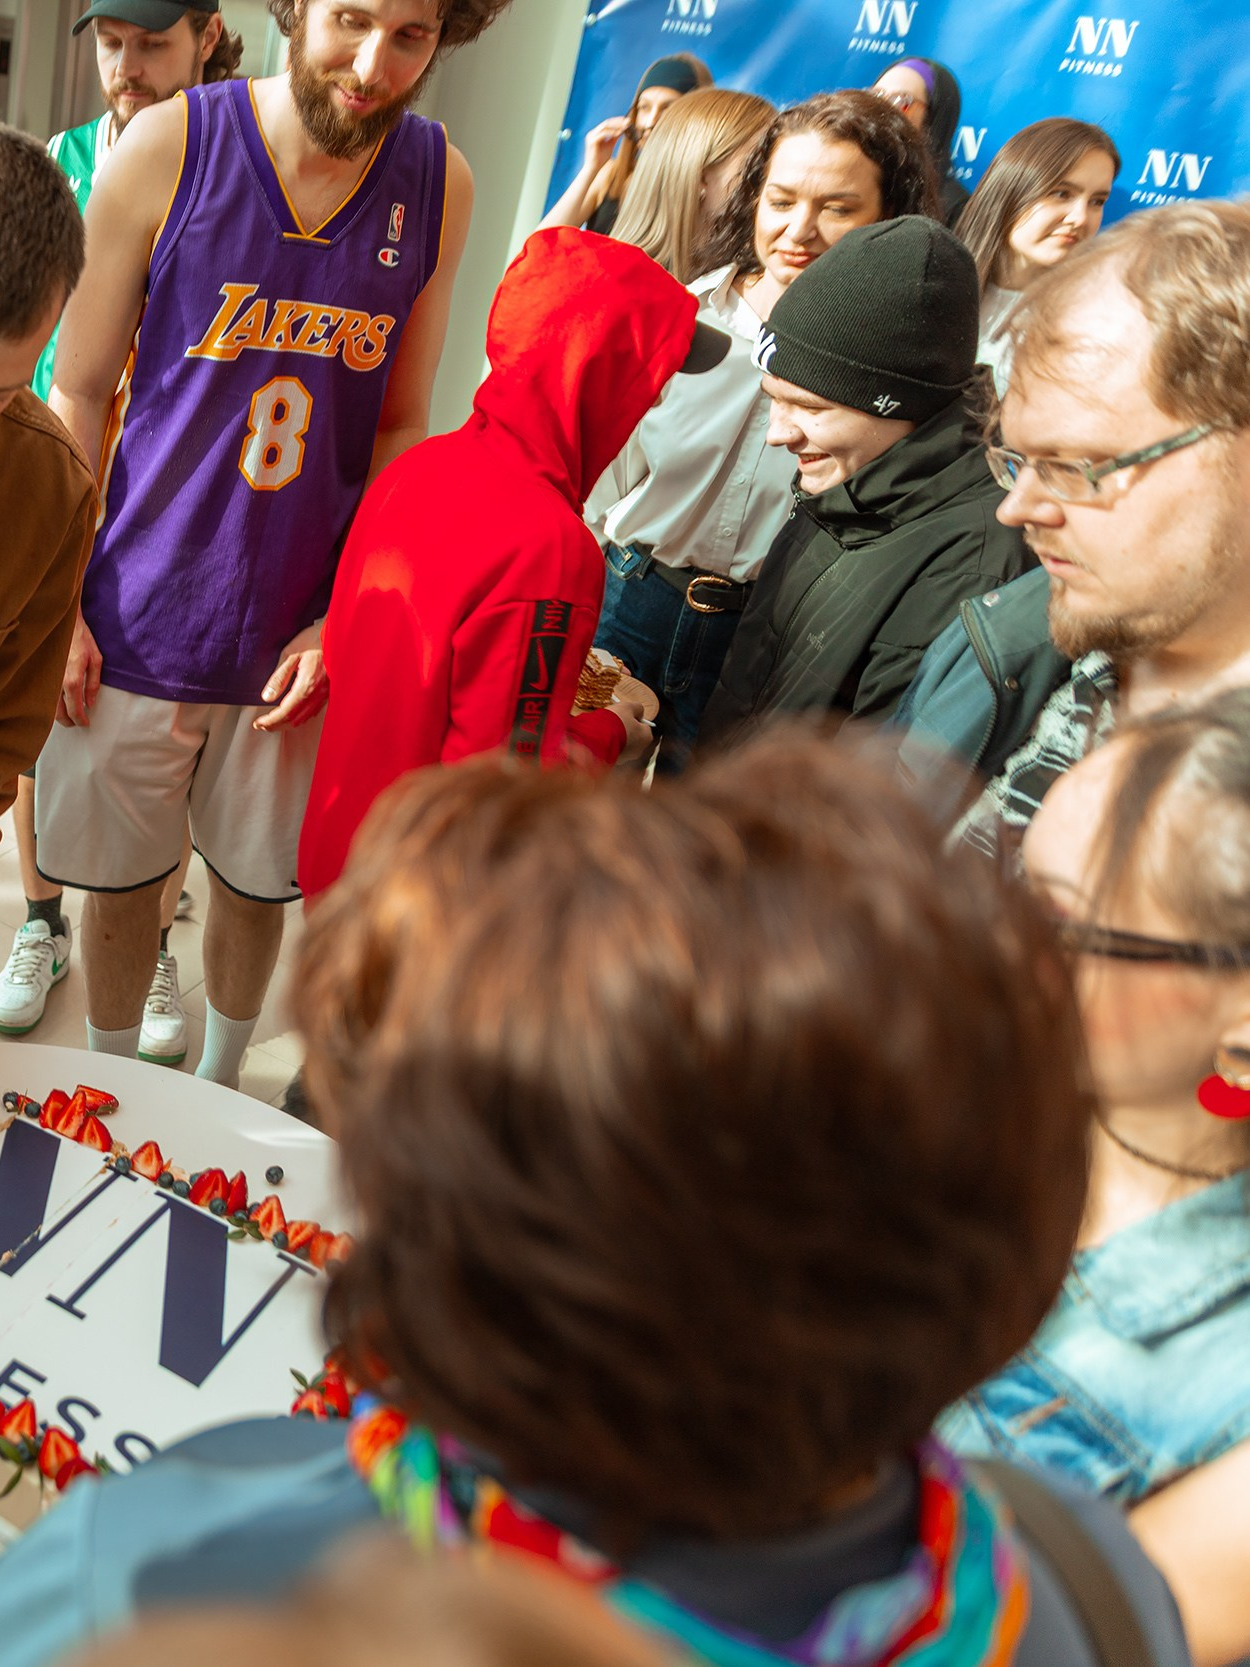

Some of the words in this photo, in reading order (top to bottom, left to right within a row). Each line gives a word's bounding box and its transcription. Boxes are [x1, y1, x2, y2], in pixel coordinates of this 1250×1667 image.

[660, 19, 712, 37] FITNESS
[854, 0, 918, 37] NN
[1065, 15, 1141, 58] NN
[847, 37, 905, 56] FITNESS
[1057, 57, 1123, 78] FITNESS
[950, 125, 988, 163] N
[1136, 147, 1214, 192] NN
[1129, 189, 1196, 207] FITNE
[184, 282, 396, 372] LAKERS
[238, 376, 313, 491] 8
